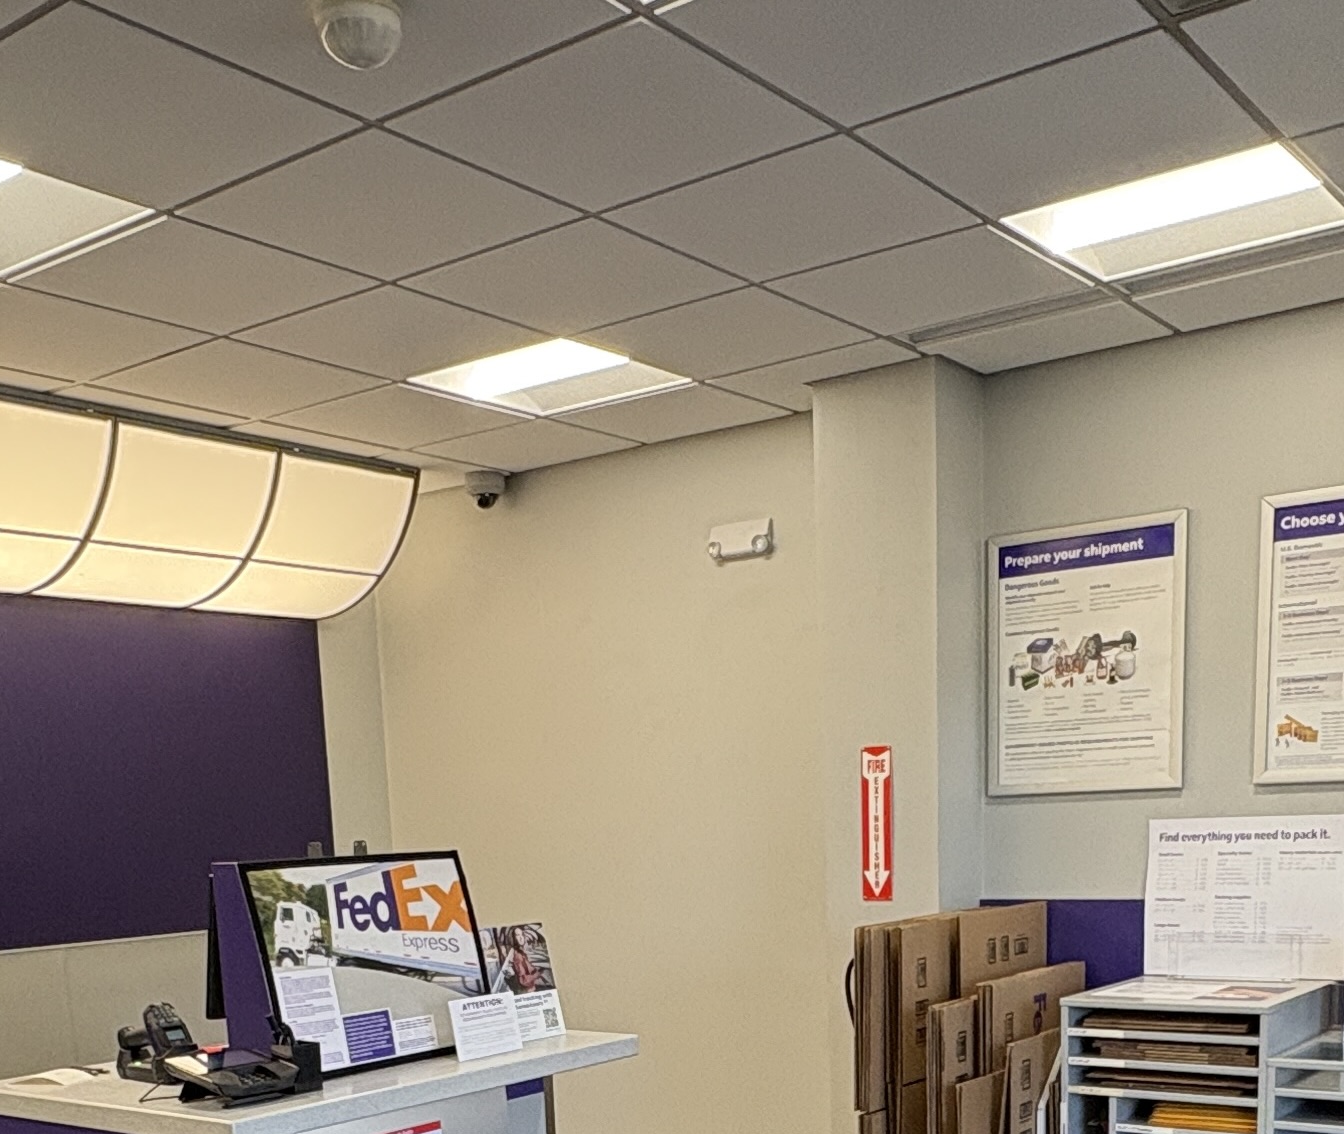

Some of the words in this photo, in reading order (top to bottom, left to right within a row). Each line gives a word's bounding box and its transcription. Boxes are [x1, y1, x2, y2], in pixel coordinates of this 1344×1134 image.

[1280, 512, 1336, 530] Choose
[1004, 552, 1052, 569] Prepare
[1053, 547, 1082, 566] your
[1083, 538, 1144, 558] shipment
[868, 759, 886, 773] FIRE
[1159, 832, 1179, 842] Find
[1181, 831, 1232, 844] everything
[1234, 832, 1252, 843] you
[1254, 830, 1278, 841] need
[1280, 829, 1291, 839] to
[1293, 829, 1317, 842] pack
[1319, 828, 1330, 839] it.
[334, 863, 472, 932] FedEx
[402, 933, 460, 952] Express
